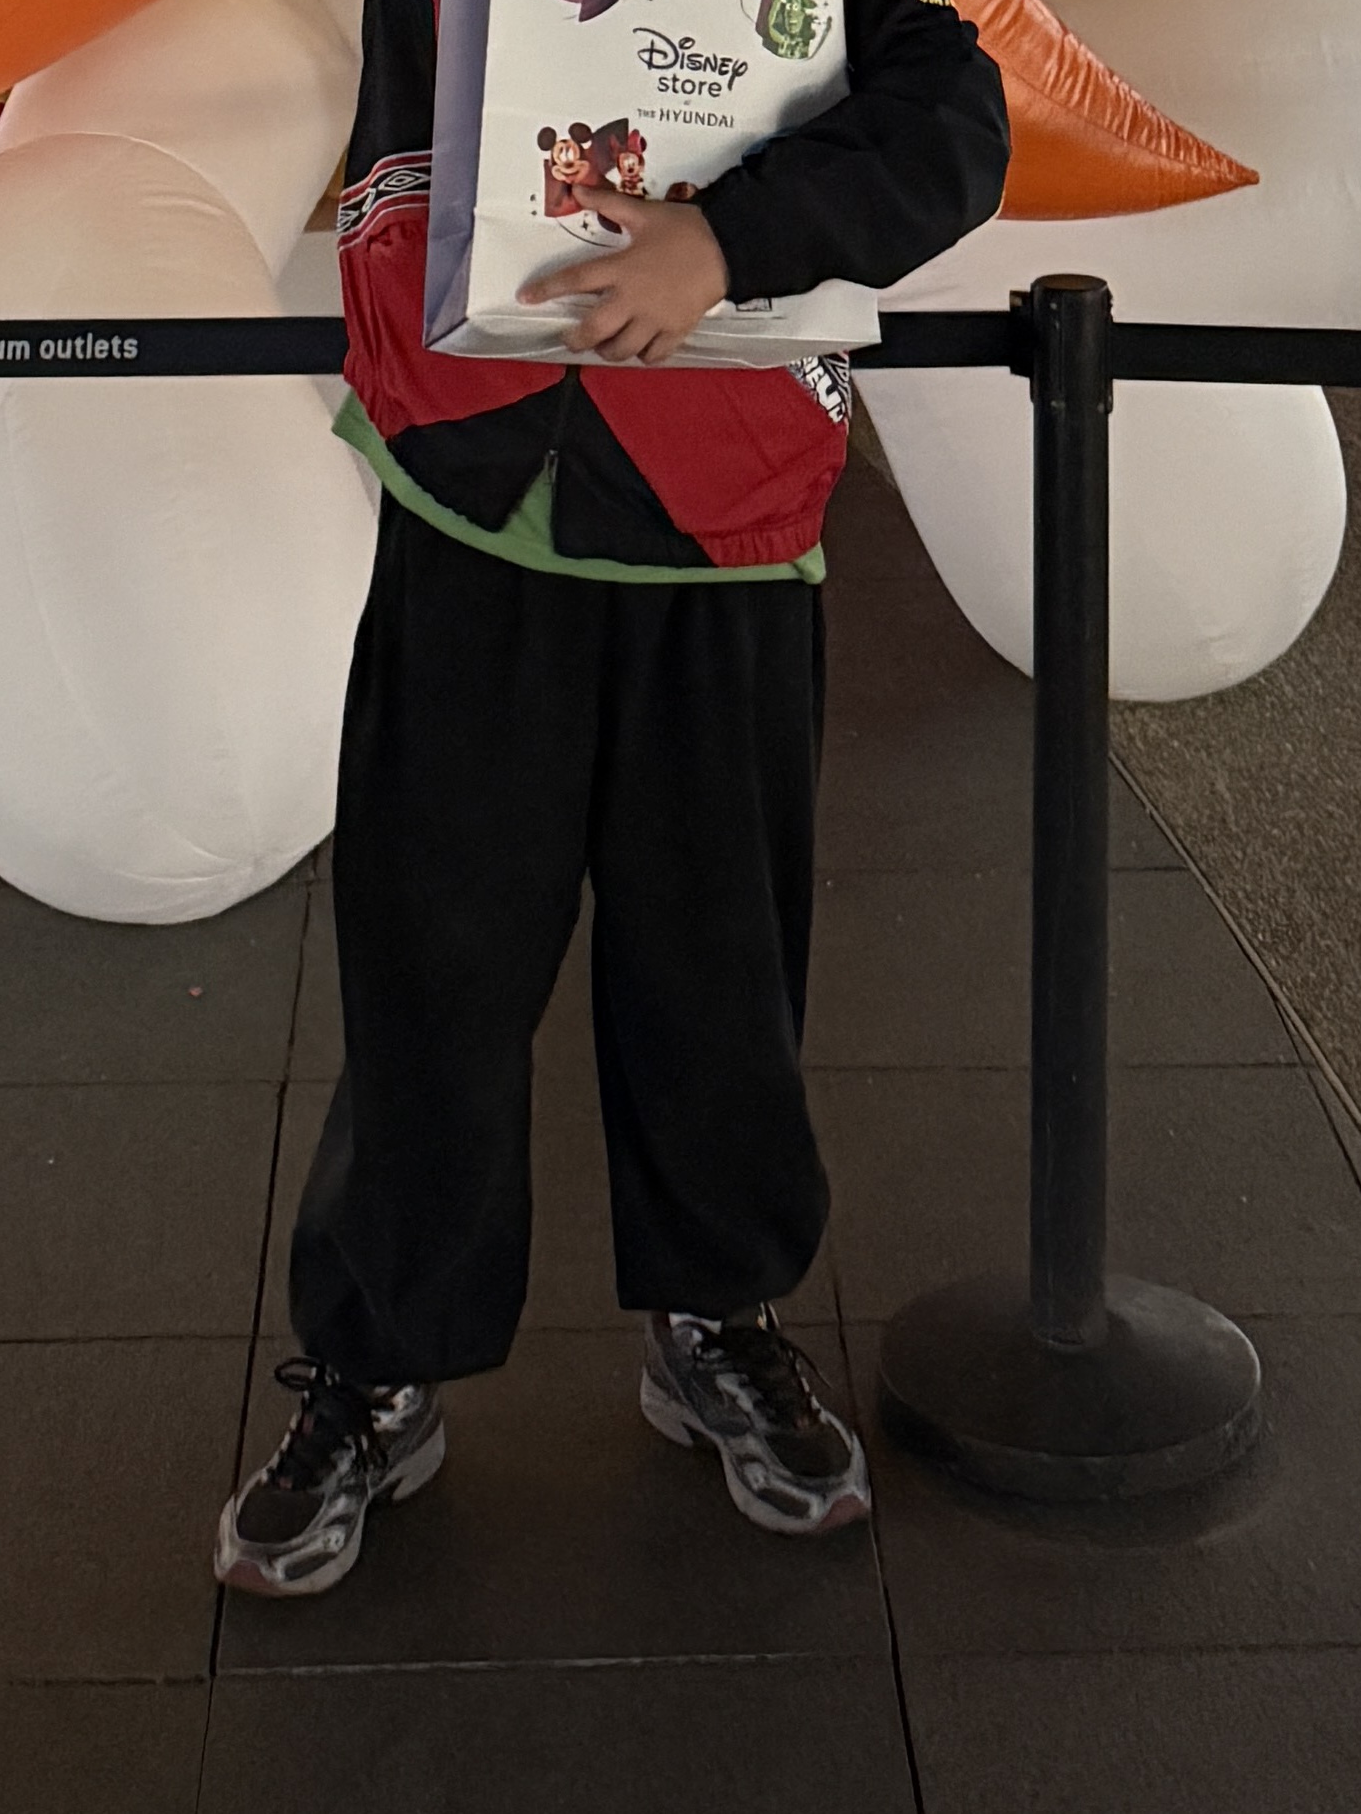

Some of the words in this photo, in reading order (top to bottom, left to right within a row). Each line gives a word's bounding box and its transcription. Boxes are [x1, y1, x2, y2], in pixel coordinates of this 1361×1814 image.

[632, 27, 748, 91] Disney
[657, 73, 722, 98] store
[659, 108, 735, 129] HYUNDAI
[39, 332, 138, 360] outlets
